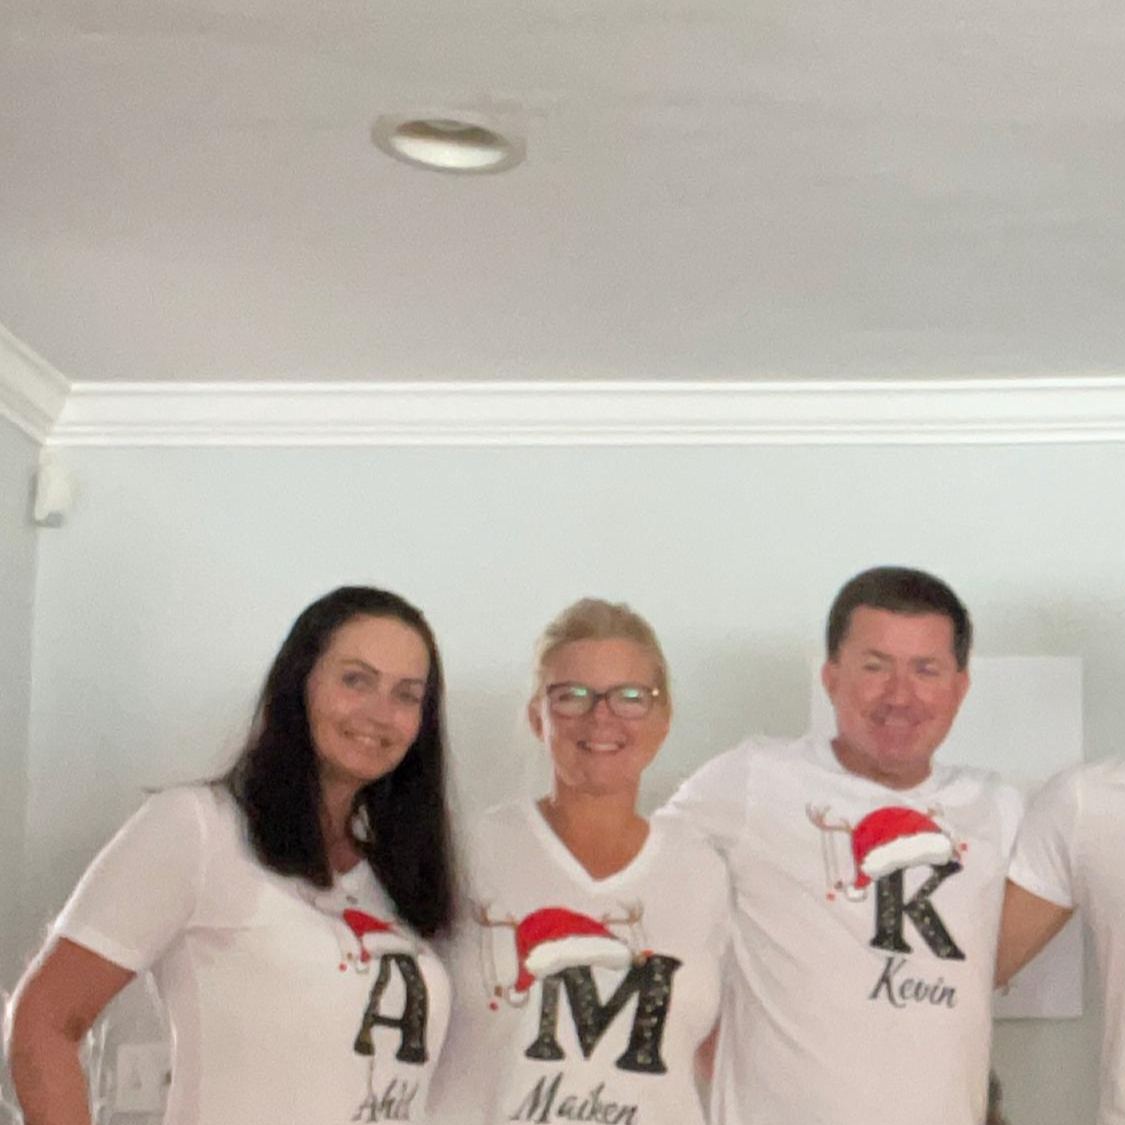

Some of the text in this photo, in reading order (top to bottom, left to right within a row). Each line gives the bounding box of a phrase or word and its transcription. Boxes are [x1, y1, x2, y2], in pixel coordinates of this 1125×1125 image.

[869, 860, 966, 961] K
[353, 953, 428, 1064] A
[525, 953, 683, 1075] M
[868, 956, 958, 1010] Kevin
